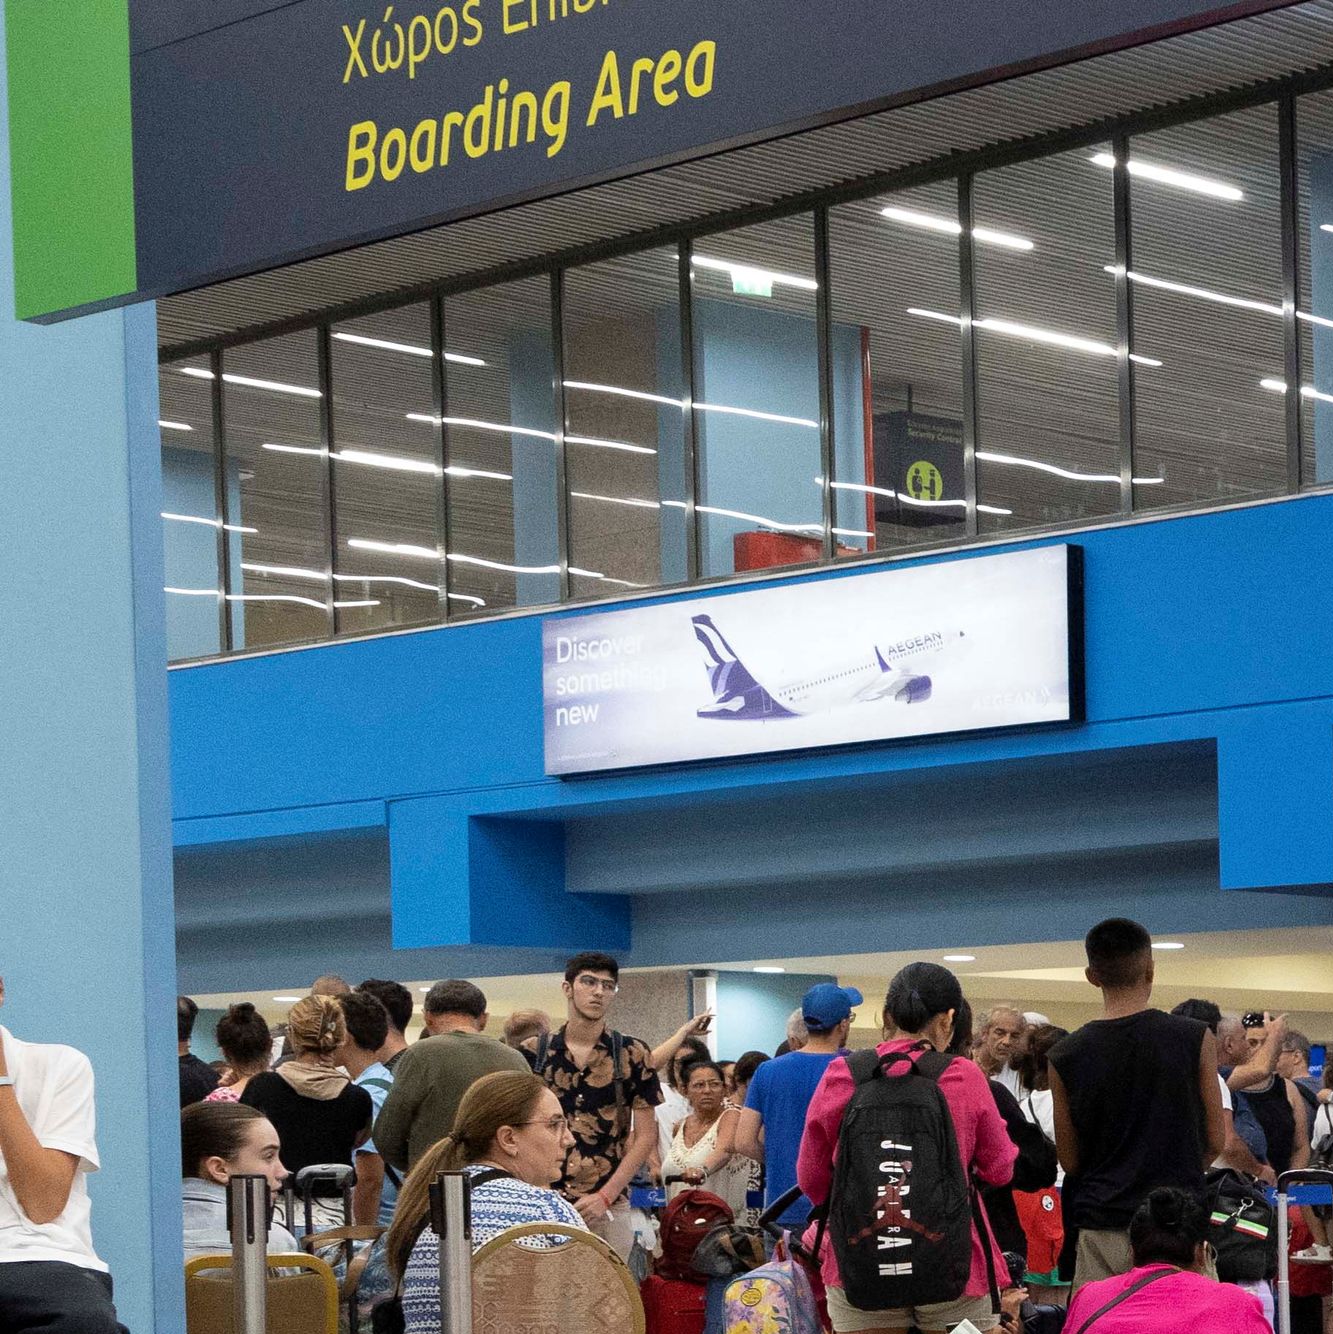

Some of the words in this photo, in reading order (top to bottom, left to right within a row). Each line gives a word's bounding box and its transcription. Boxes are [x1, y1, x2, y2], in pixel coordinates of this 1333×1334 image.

[345, 78, 571, 192] Boarding
[586, 40, 717, 127] Area
[555, 635, 645, 663] Discover
[887, 630, 943, 656] AEGEAN
[555, 703, 600, 727] new
